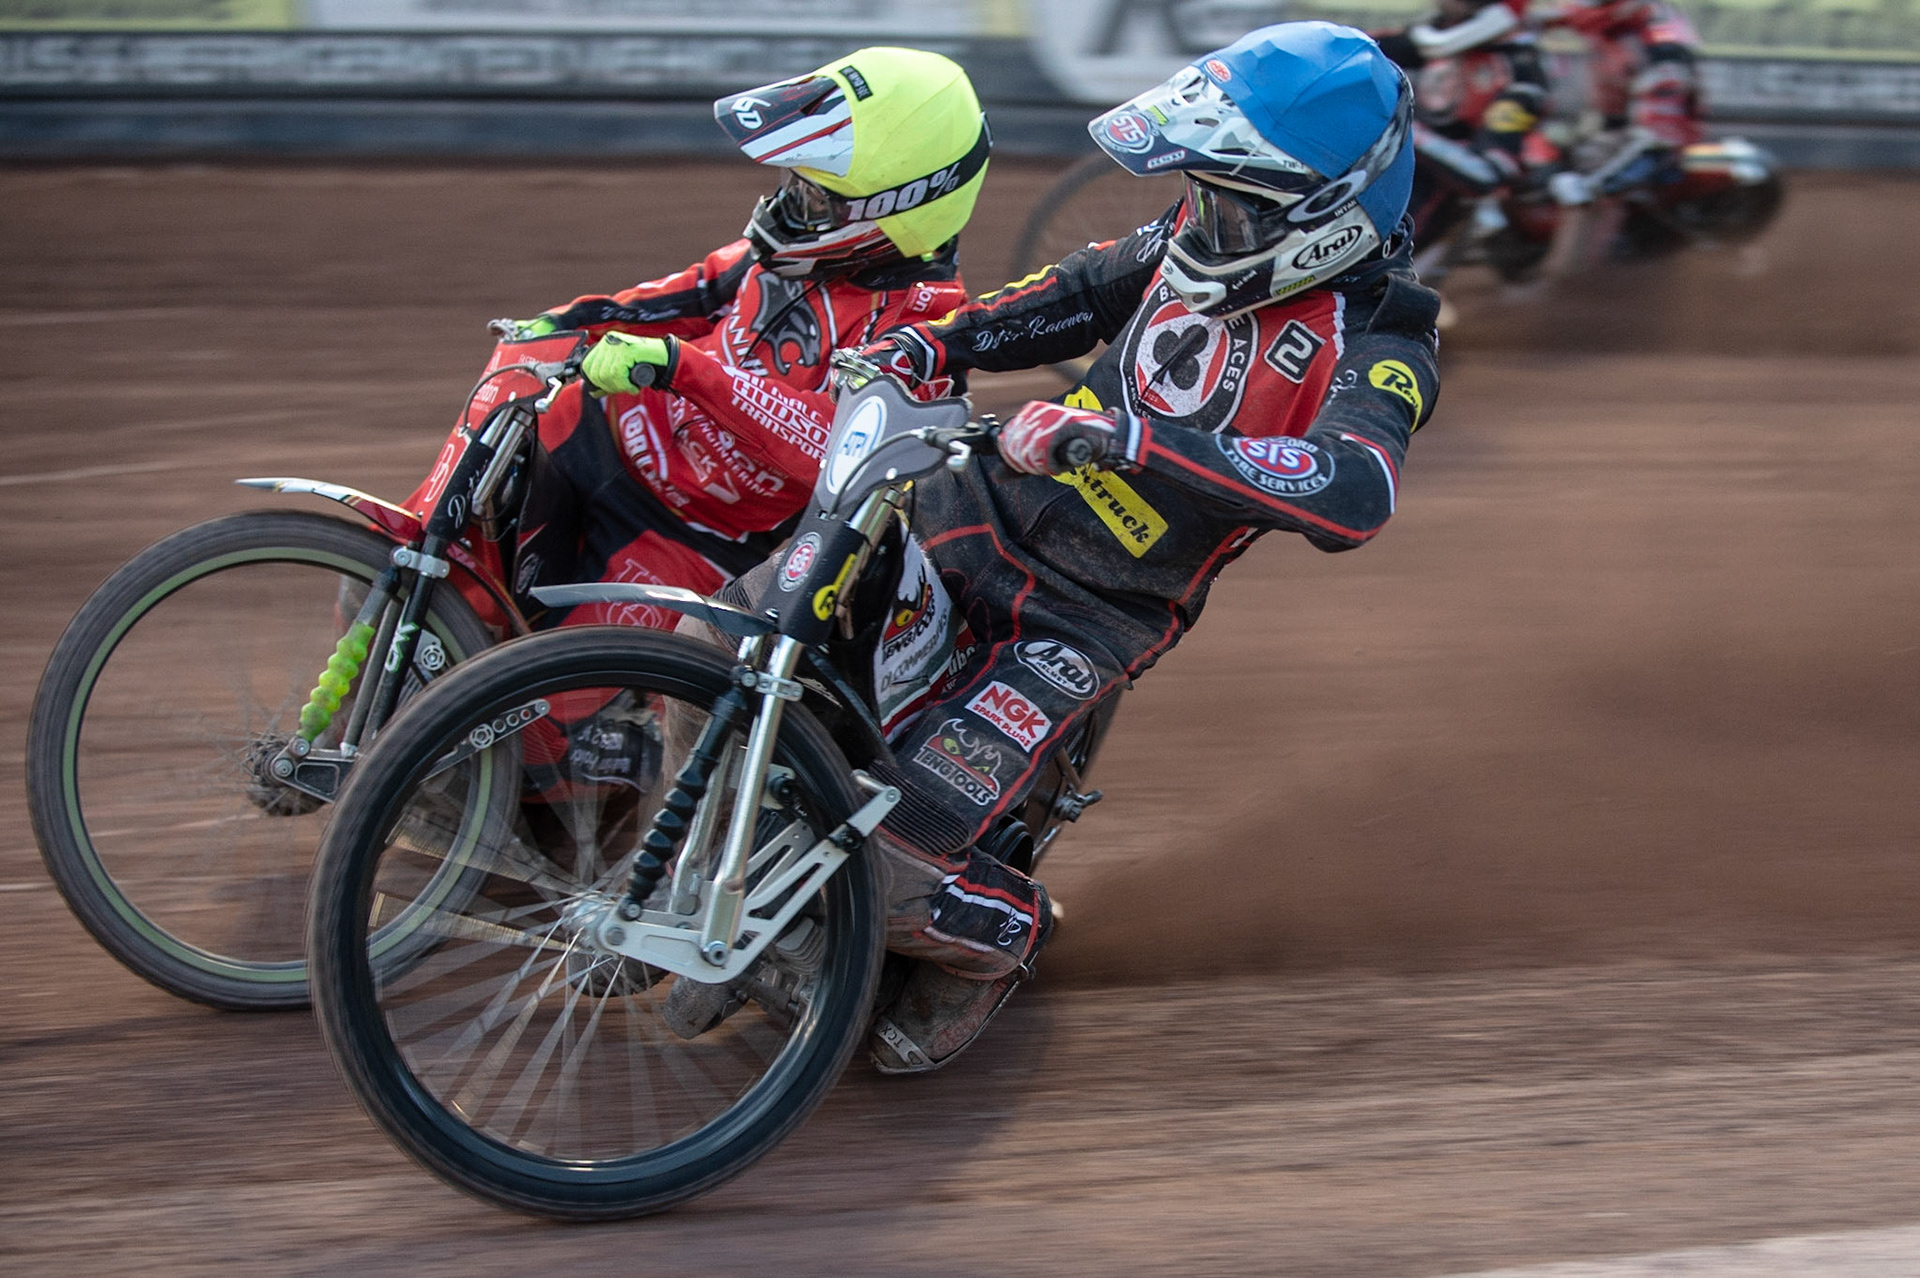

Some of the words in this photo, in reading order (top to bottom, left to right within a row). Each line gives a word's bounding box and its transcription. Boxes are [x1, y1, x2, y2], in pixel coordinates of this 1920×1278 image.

[846, 161, 961, 222] 100%
[1297, 226, 1358, 268] Arai
[1221, 337, 1249, 393] ACES
[1273, 328, 1314, 376] 2
[730, 392, 827, 461] TRANSPOR
[733, 379, 829, 448] HUDSO
[1246, 440, 1301, 470] STS
[1259, 472, 1329, 493] SERVICES
[1021, 642, 1094, 691] Arai
[1034, 660, 1068, 686] HELMET
[972, 703, 1004, 727] SPARK
[979, 684, 1046, 740] NGK
